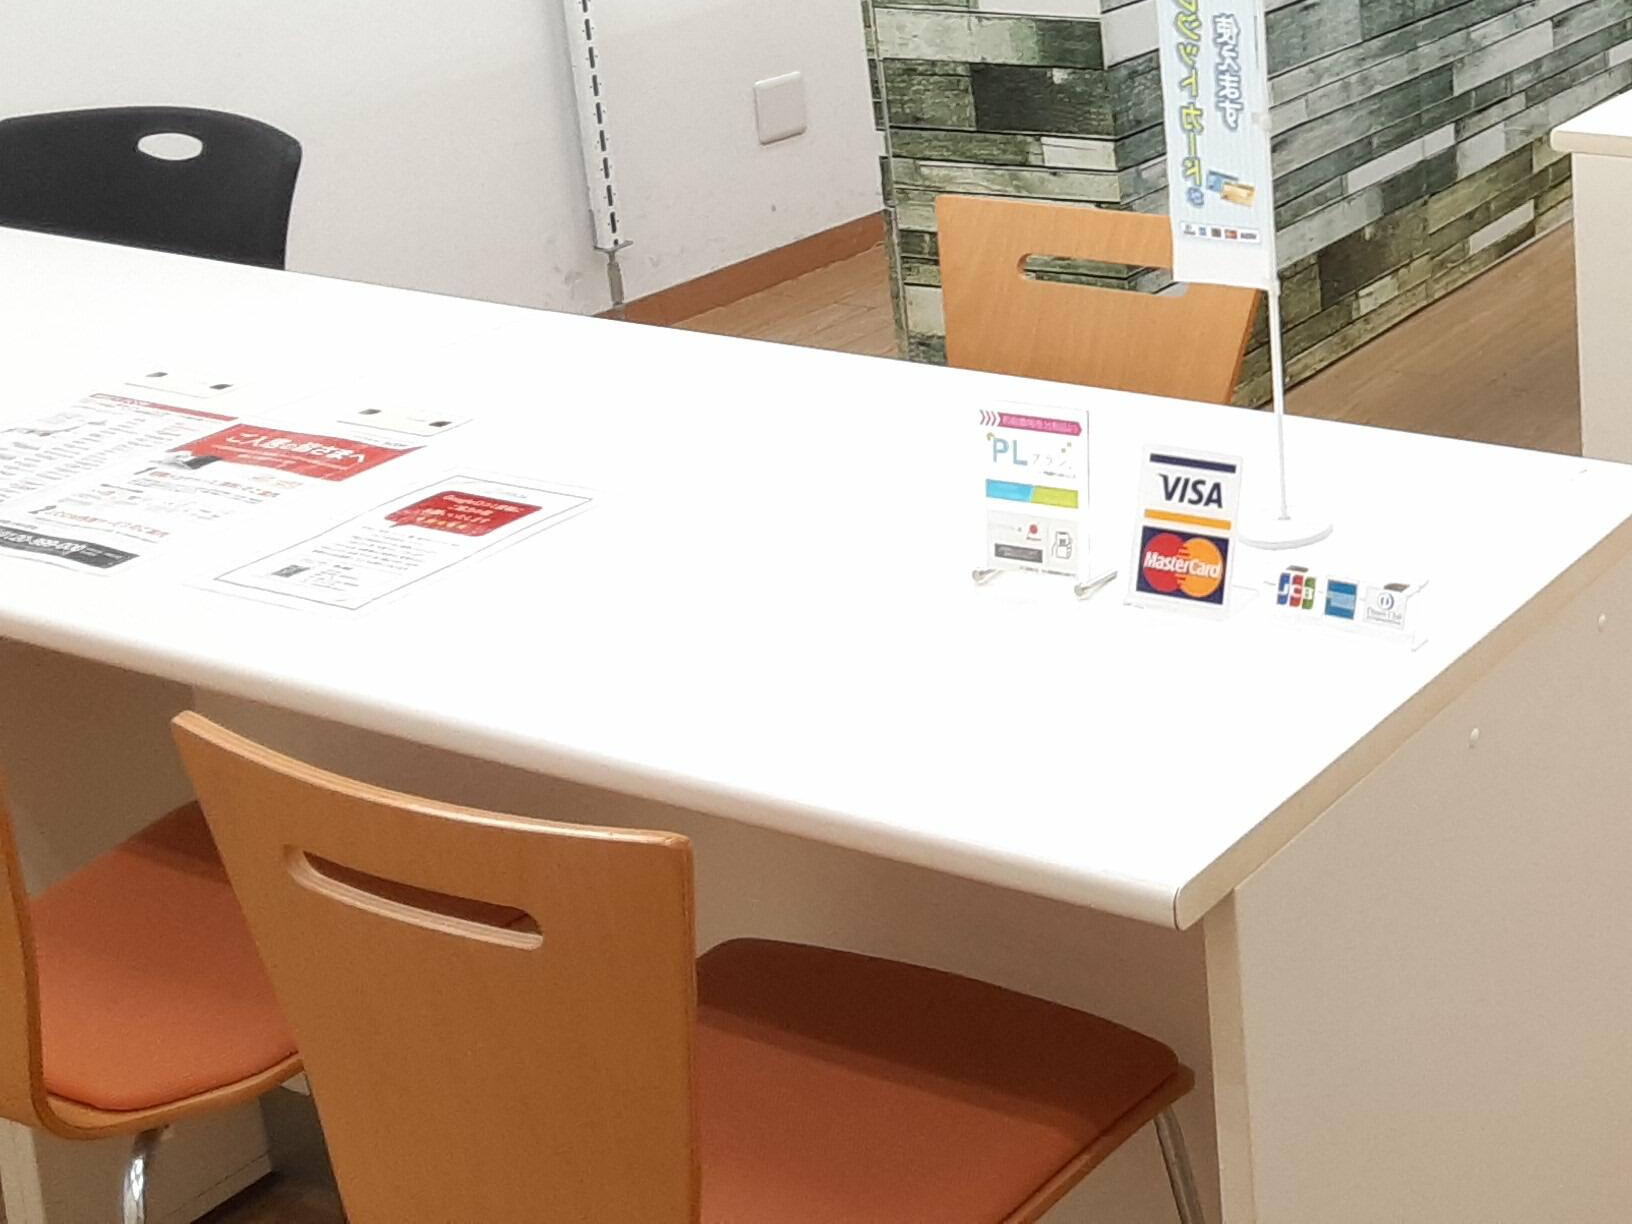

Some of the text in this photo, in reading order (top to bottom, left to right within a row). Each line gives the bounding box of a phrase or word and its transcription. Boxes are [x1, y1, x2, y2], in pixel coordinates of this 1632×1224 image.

[1158, 472, 1224, 510] VISA
[1142, 550, 1224, 581] MasterCard
[1276, 572, 1317, 611] JCB
